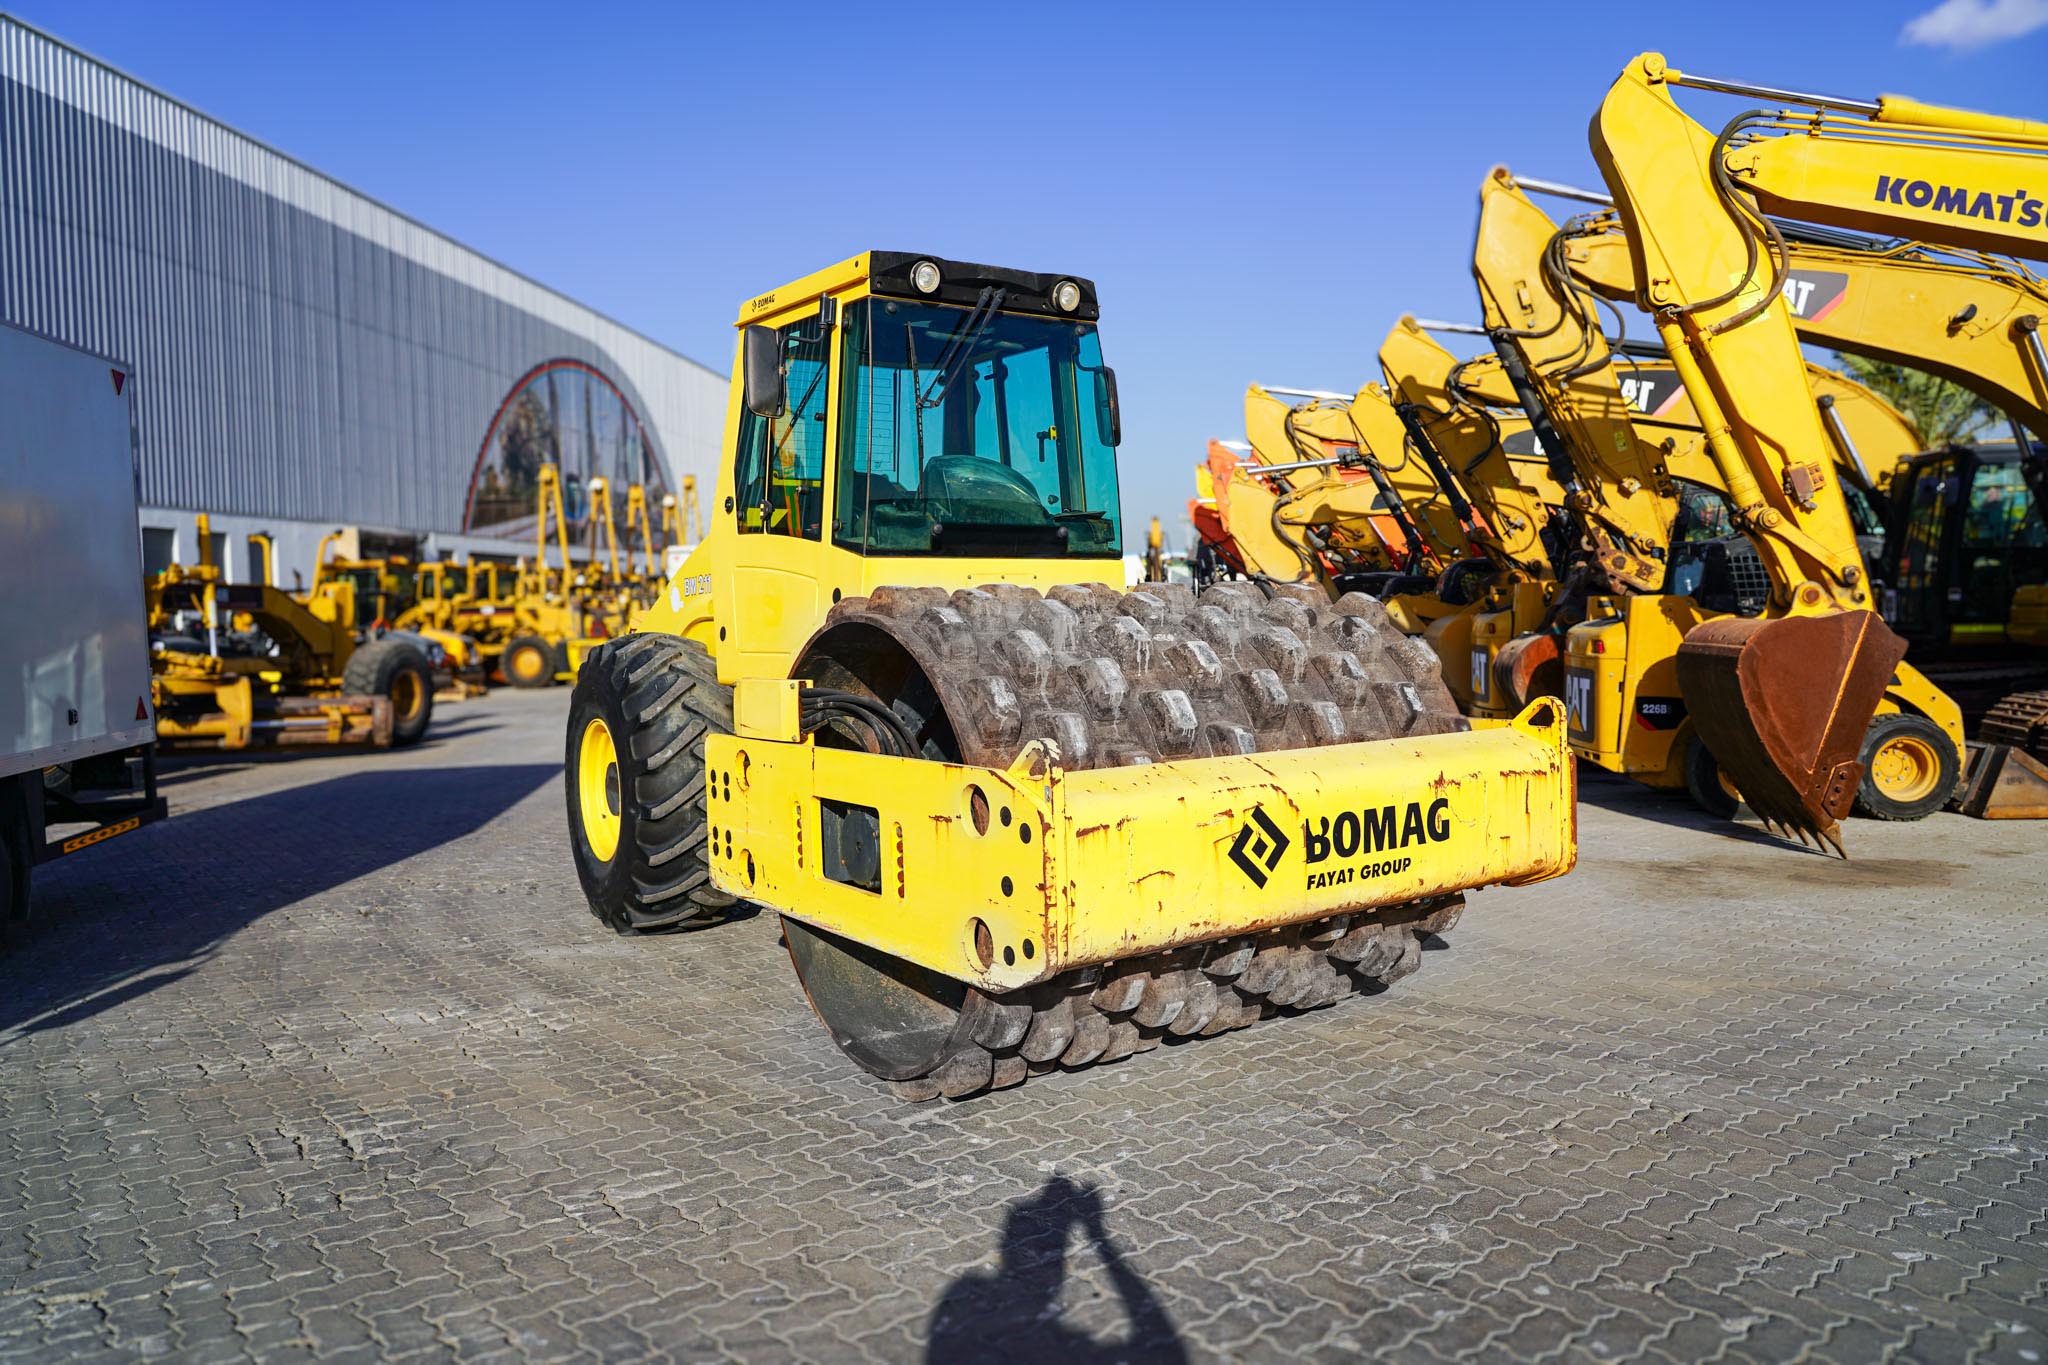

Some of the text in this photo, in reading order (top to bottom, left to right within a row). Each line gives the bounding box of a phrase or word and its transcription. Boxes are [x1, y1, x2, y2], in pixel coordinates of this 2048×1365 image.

[1874, 174, 2048, 228] KOMATS
[1782, 278, 1816, 316] AT
[1618, 378, 1656, 412] AT
[1306, 797, 1450, 863] BOMAG
[1307, 857, 1412, 890] FAYAT GROUP
